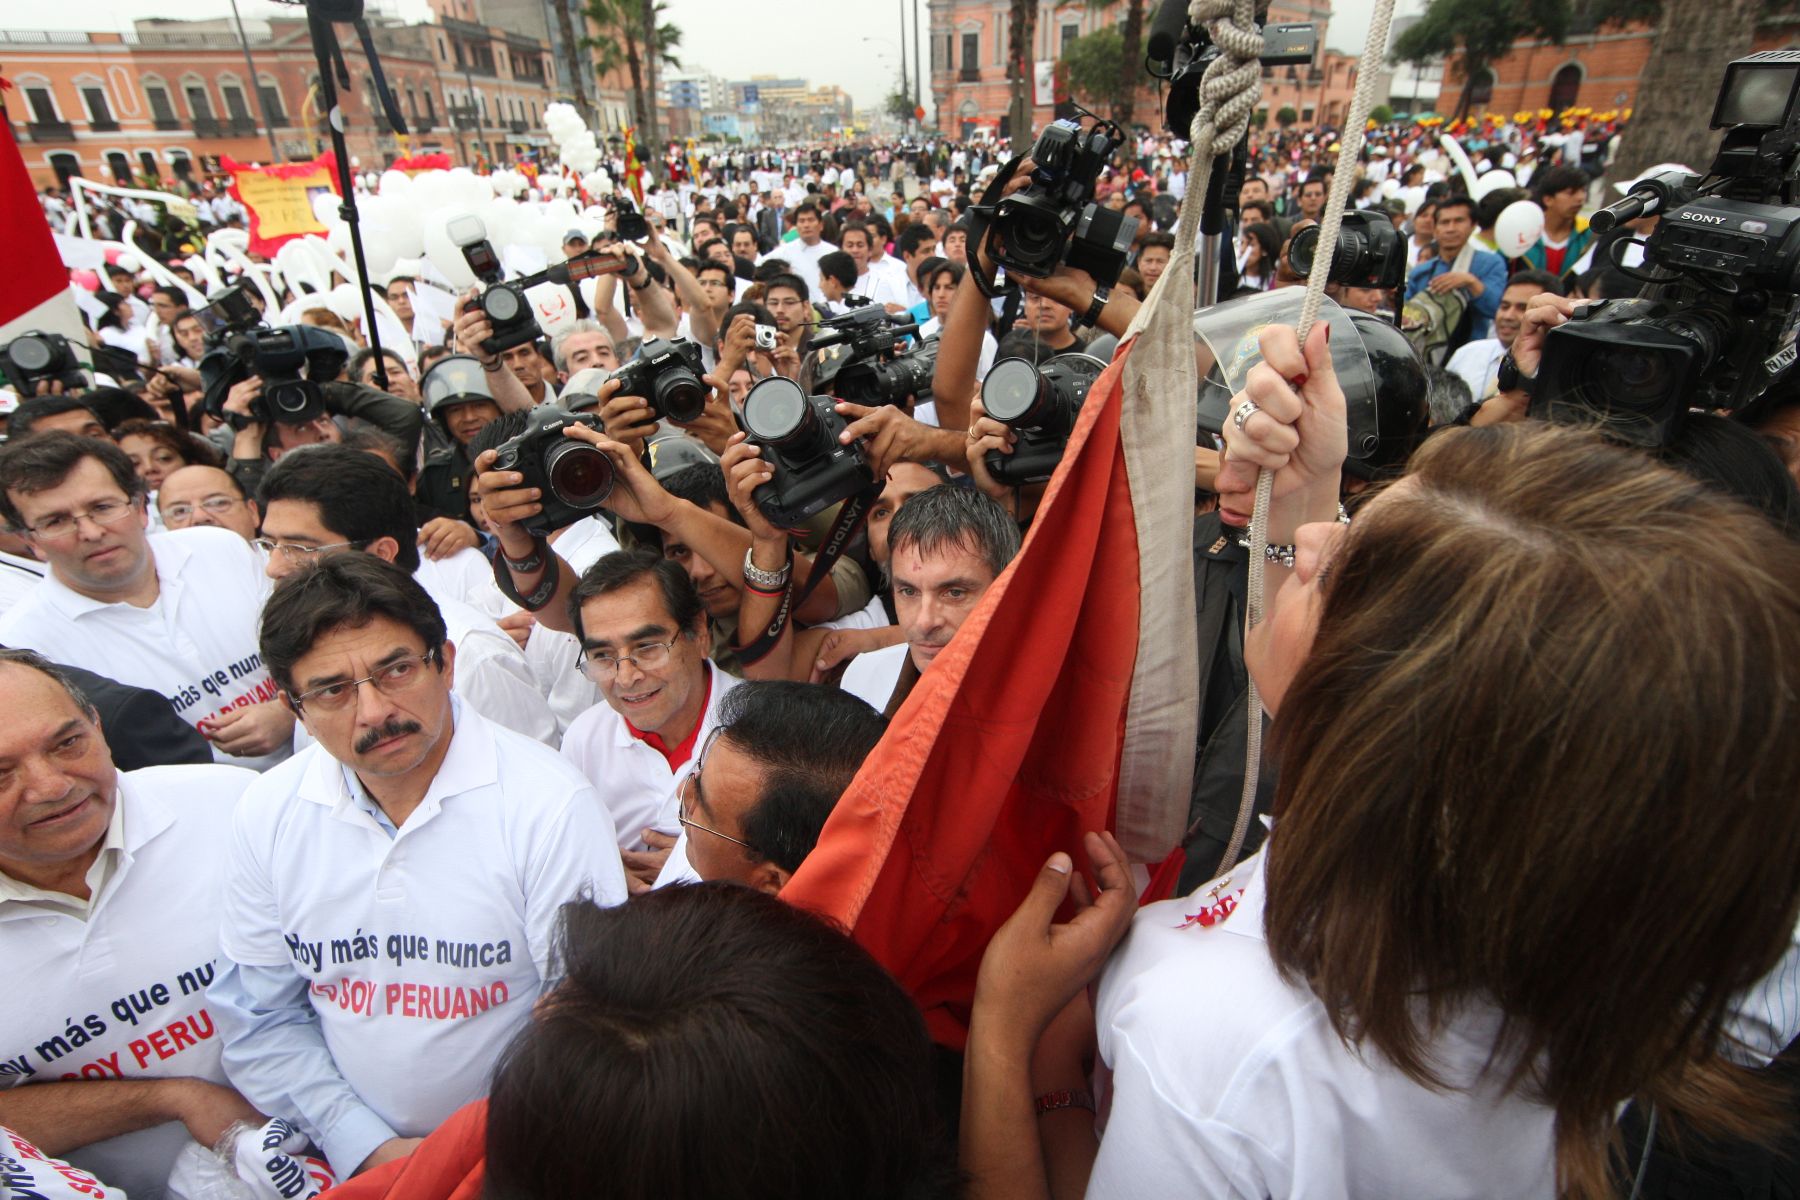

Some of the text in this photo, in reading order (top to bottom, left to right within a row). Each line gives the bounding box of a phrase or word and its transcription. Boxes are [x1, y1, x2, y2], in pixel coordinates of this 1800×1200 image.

[1681, 211, 1727, 225] SONY
[652, 352, 671, 365] Canon
[542, 419, 564, 431] Canon
[228, 653, 261, 680] nun
[331, 928, 378, 964] más
[386, 932, 429, 967] que
[436, 938, 512, 969] nunca
[34, 1016, 107, 1063] más
[110, 982, 171, 1026] que
[176, 959, 217, 996] nu
[339, 976, 377, 1017] SOY
[385, 979, 509, 1020] PERUANO
[127, 1008, 217, 1070] PERU
